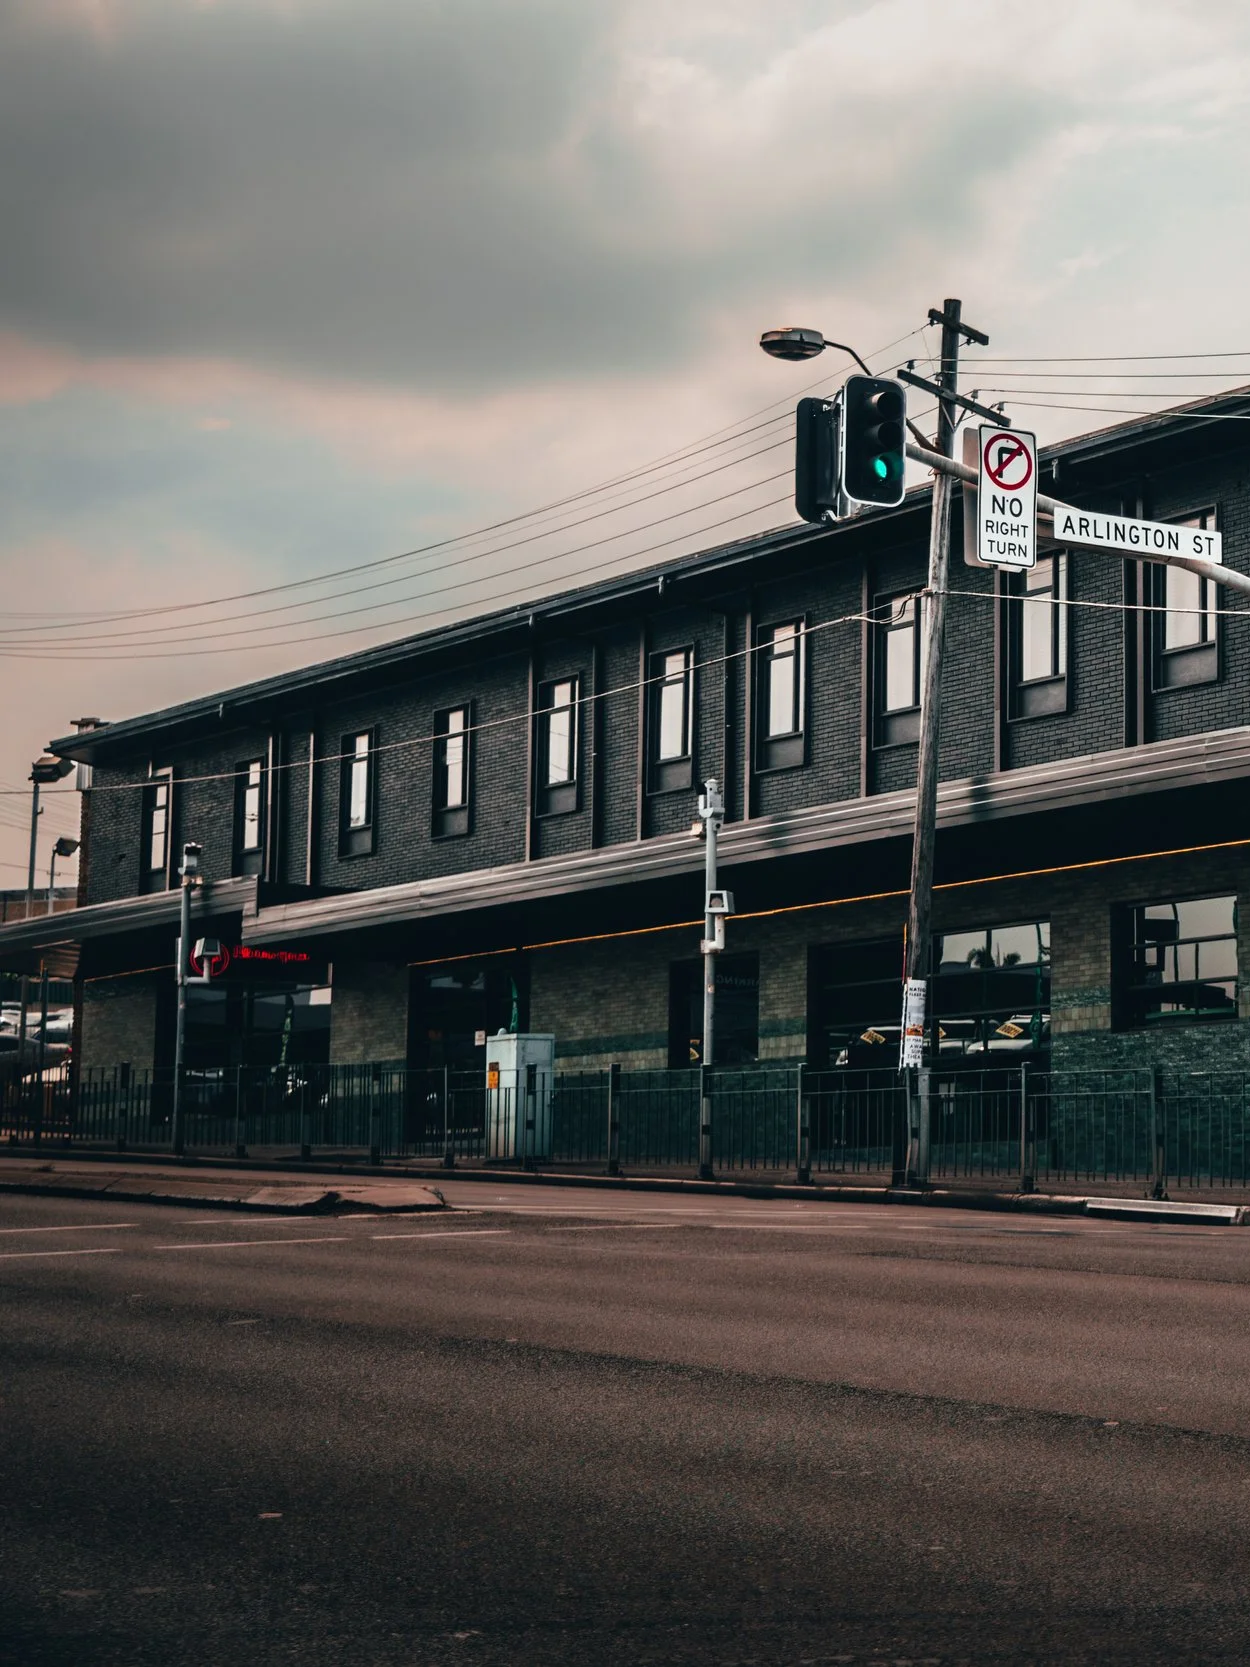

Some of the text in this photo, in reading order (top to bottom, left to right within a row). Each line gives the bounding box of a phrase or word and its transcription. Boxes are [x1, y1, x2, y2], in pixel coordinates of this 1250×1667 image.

[992, 494, 1023, 518] NO
[985, 519, 1029, 538] RIGHT
[1063, 515, 1214, 556] ARLINGTON ST
[987, 539, 1027, 558] TURN
